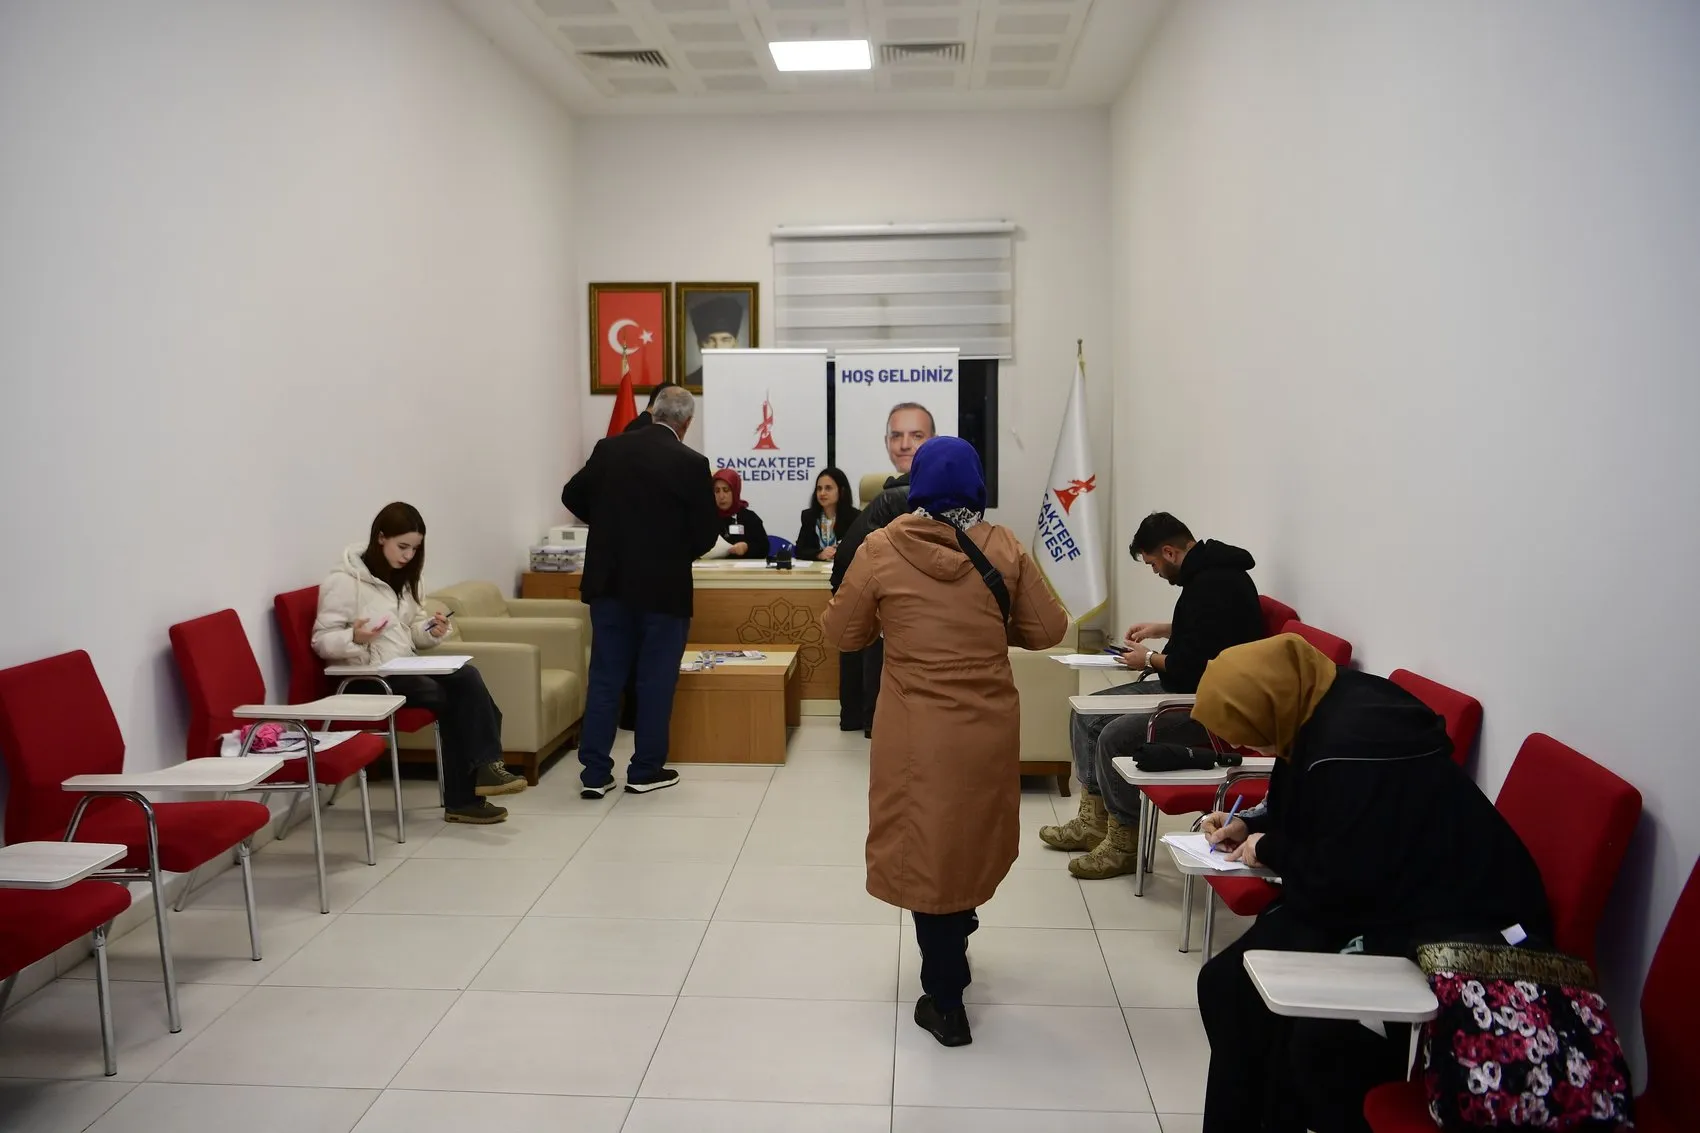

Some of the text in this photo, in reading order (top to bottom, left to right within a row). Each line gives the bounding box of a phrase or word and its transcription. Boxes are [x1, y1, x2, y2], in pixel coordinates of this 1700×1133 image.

[842, 365, 953, 386] HOŞ GELDİNİZ
[716, 457, 815, 468] SANCAKTEPE
[738, 470, 809, 481] LEDİYESİ
